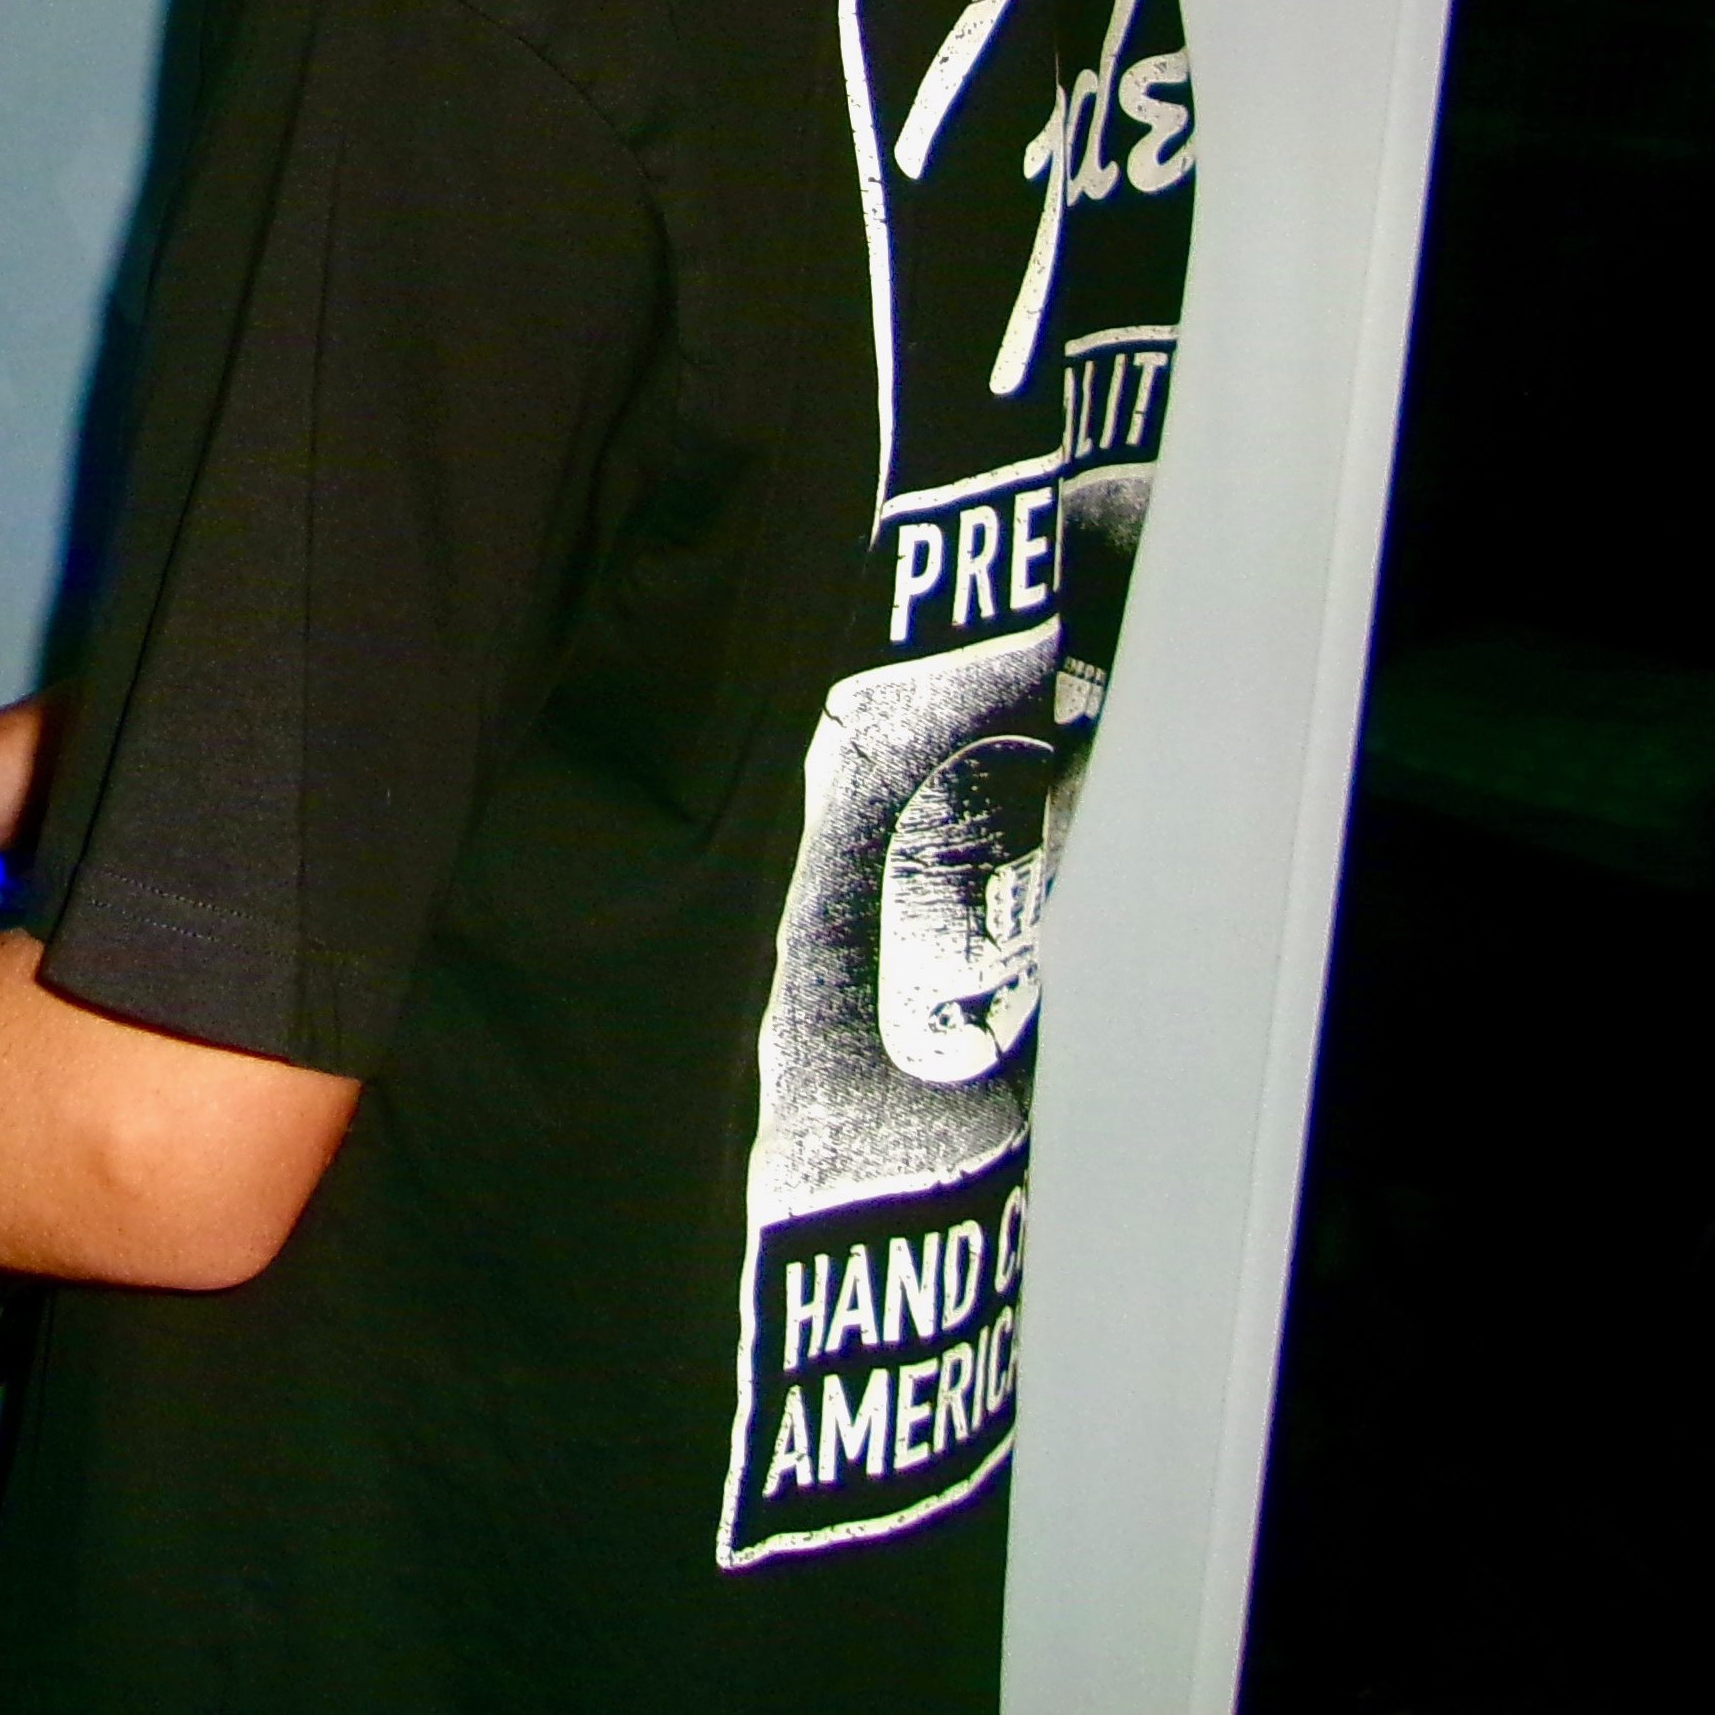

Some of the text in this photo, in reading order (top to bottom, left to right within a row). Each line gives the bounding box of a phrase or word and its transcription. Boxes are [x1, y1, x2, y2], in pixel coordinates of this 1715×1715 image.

[888, 486, 1062, 642] PRE
[783, 1182, 1026, 1372] HAND C
